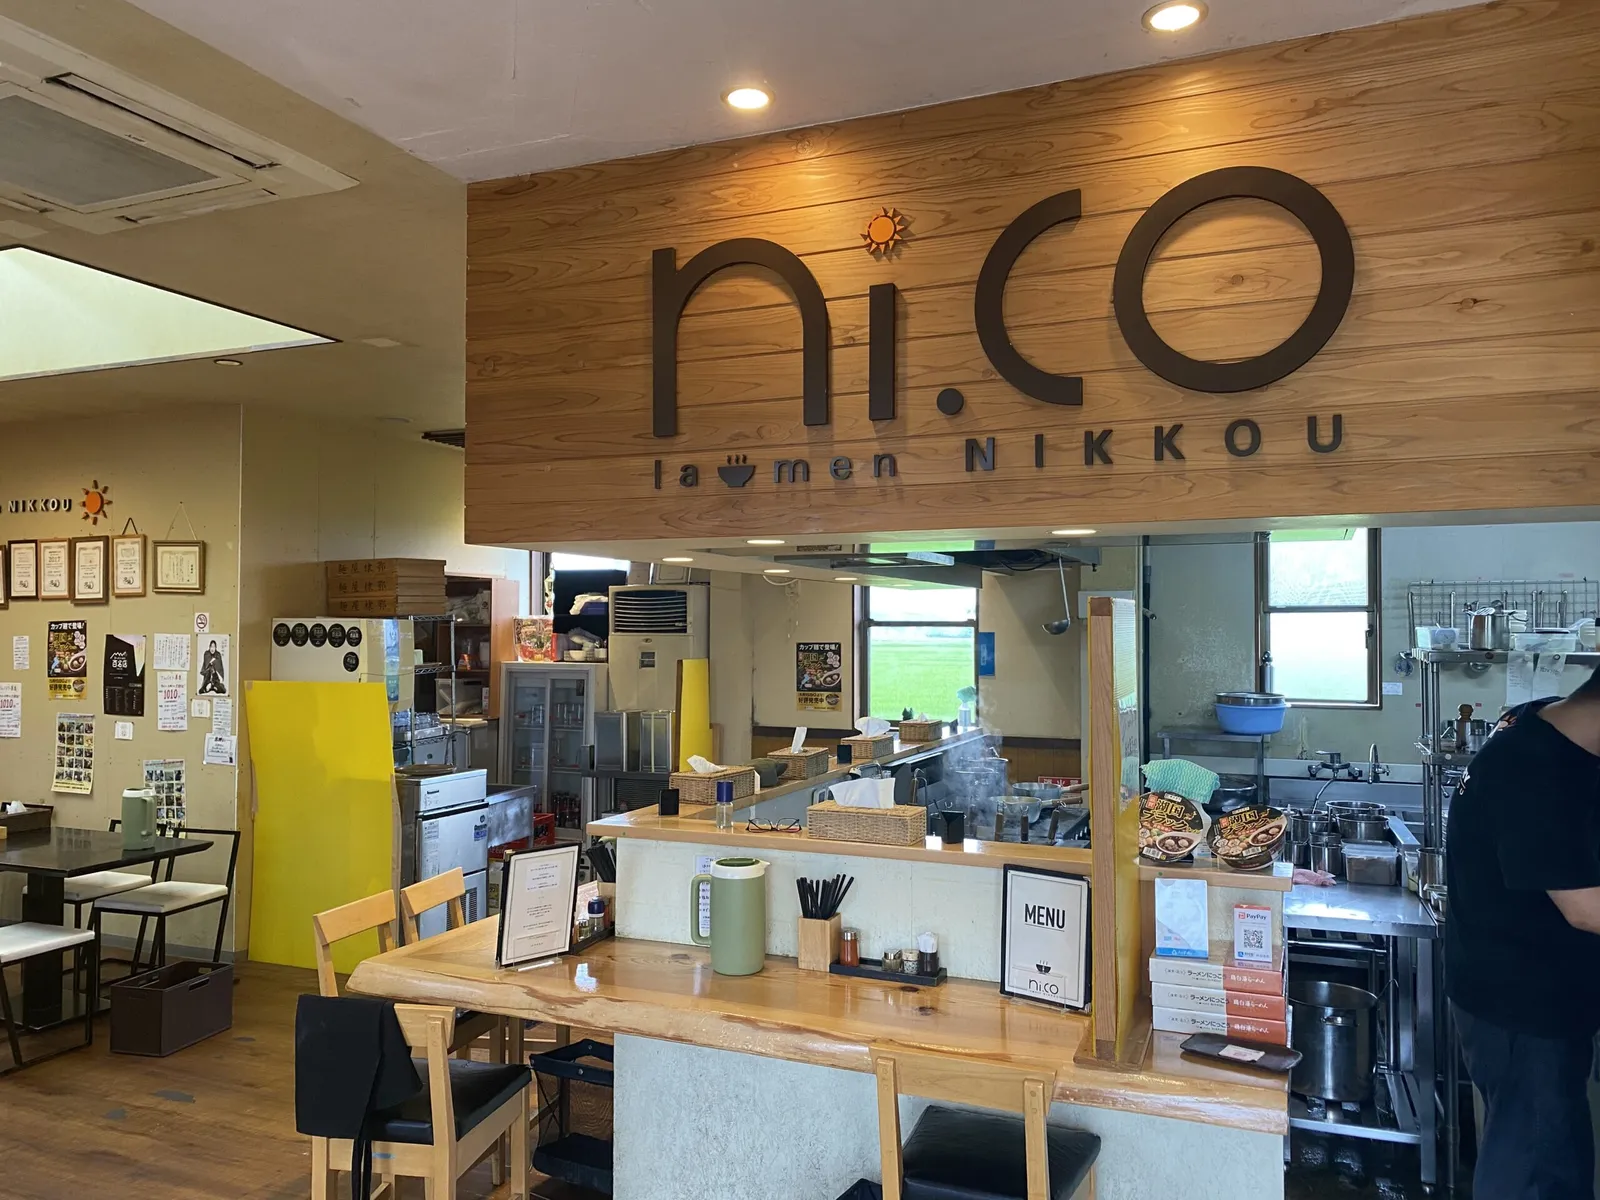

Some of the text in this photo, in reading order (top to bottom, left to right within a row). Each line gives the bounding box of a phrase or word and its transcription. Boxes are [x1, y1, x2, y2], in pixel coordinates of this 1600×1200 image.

[965, 414, 1343, 472] NIKKOU
[8, 498, 72, 513] NIKKOU
[1024, 903, 1066, 929] MENU
[1246, 911, 1267, 921] PayPay
[1187, 970, 1227, 980] ラーメンにっこう
[1190, 994, 1230, 1004] ラーメンにっこう
[1191, 1018, 1231, 1029] ラーメンにっこう
